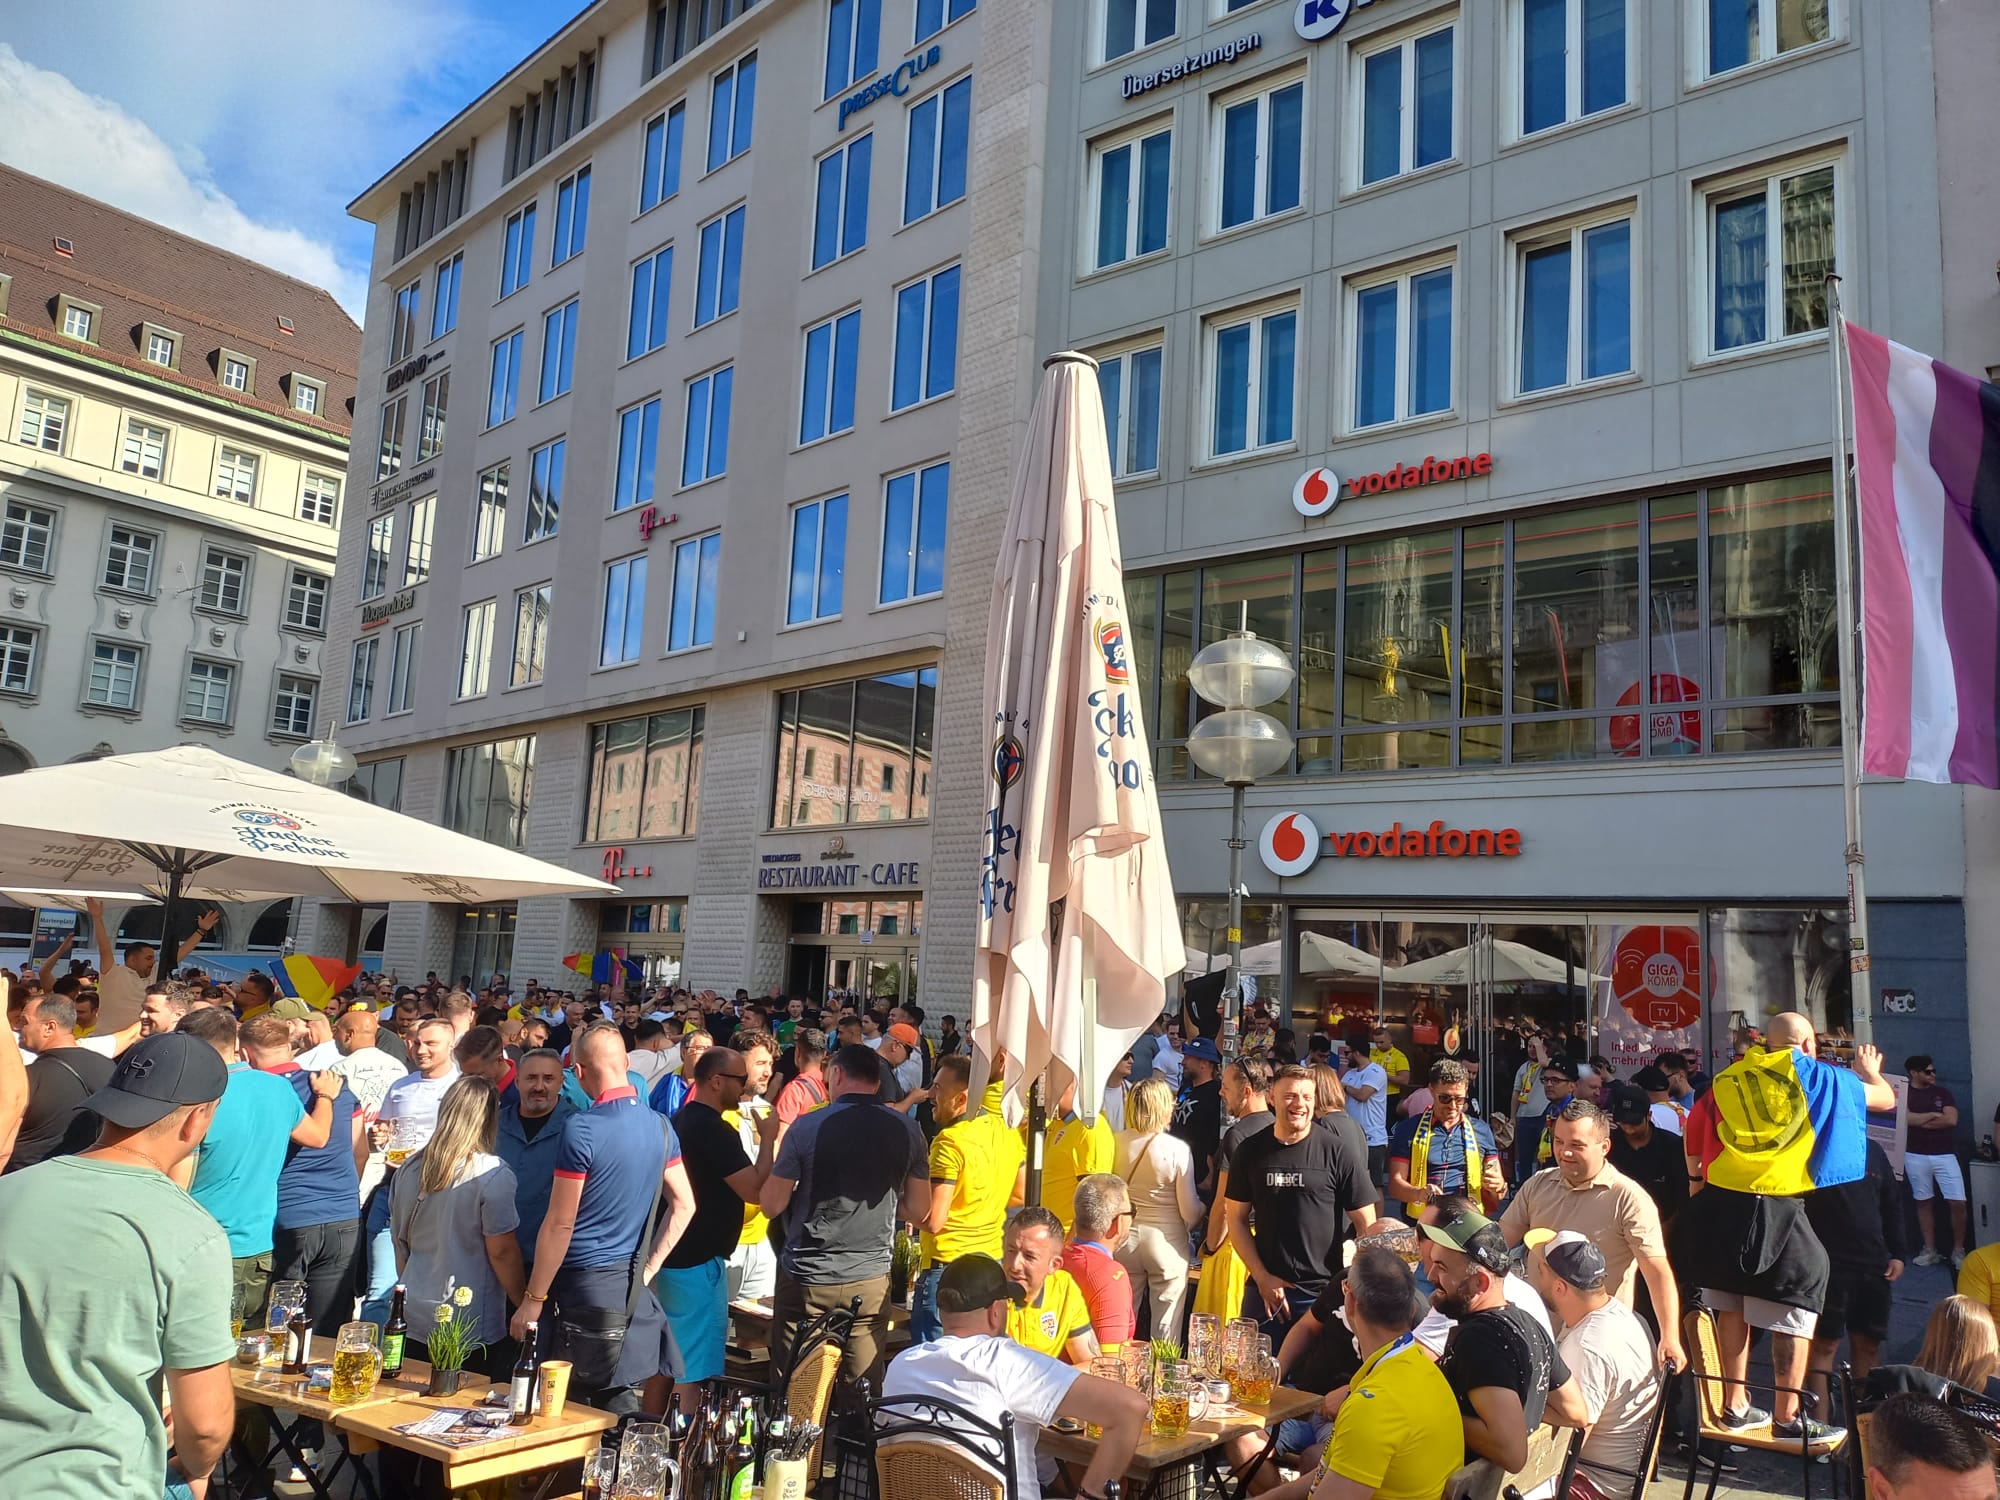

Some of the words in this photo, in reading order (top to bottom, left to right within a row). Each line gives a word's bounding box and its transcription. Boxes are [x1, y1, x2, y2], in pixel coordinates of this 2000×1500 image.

[1121, 32, 1262, 99] Übersetzungen
[1347, 452, 1493, 497] vodafone
[1652, 715, 1674, 728] IGA
[1651, 727, 1675, 738] OMBI
[232, 826, 336, 848] Hacker
[1330, 820, 1522, 858] vodafone
[239, 838, 350, 859] Pschorr
[759, 864, 860, 889] RESTAURANT
[871, 862, 919, 886] CAFE
[1647, 964, 1678, 976] GIGA
[1647, 976, 1679, 988] KOMBI
[1657, 1008, 1670, 1017] TV
[1611, 1056, 1637, 1066] mehr
